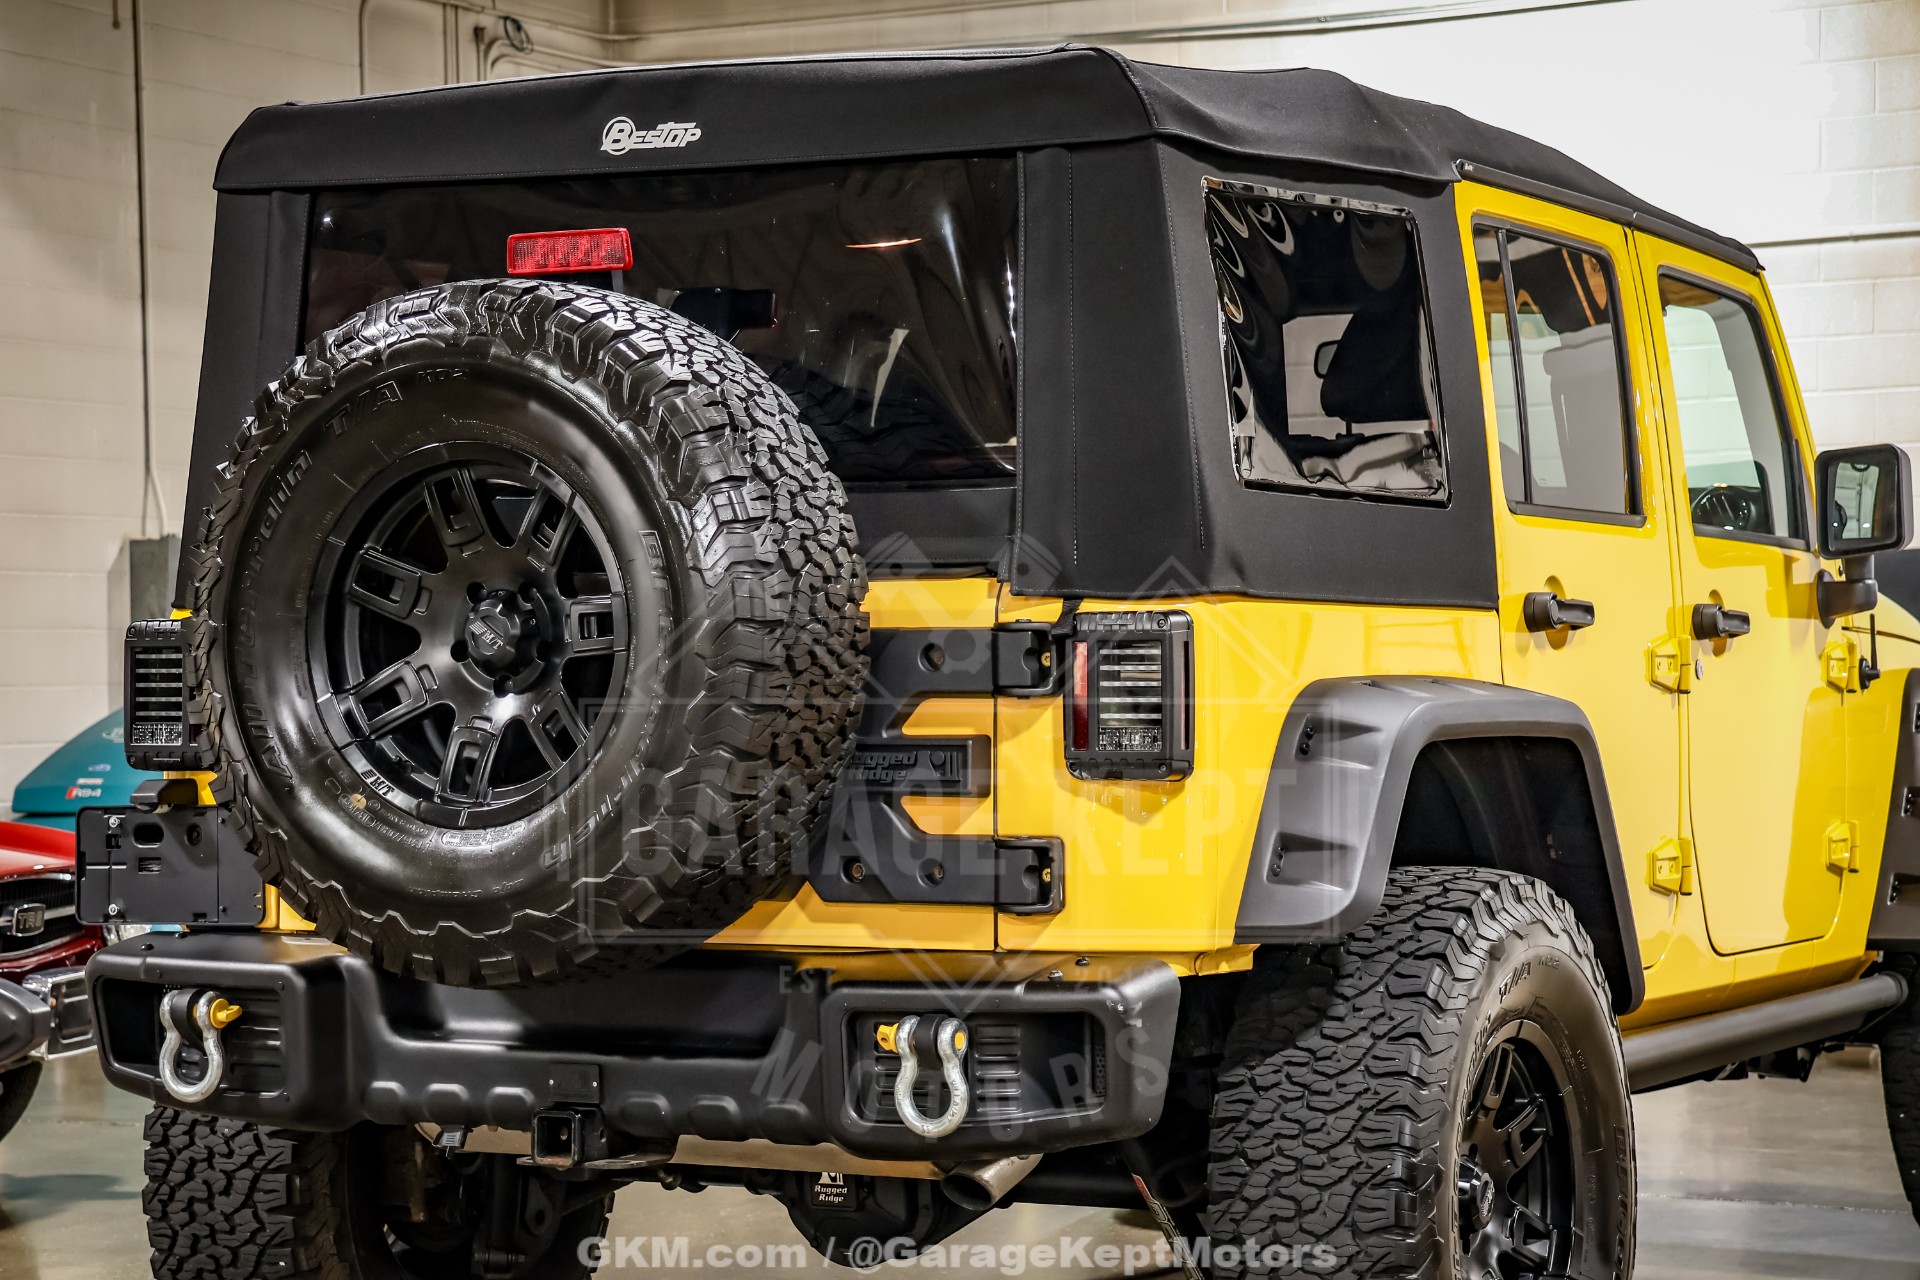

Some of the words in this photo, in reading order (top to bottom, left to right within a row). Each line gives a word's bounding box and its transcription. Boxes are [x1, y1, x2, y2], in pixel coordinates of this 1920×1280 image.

[323, 380, 403, 438] T/A
[852, 750, 918, 768] ugged
[814, 1185, 848, 1195] Rugged
[819, 1194, 844, 1204] Ridge
